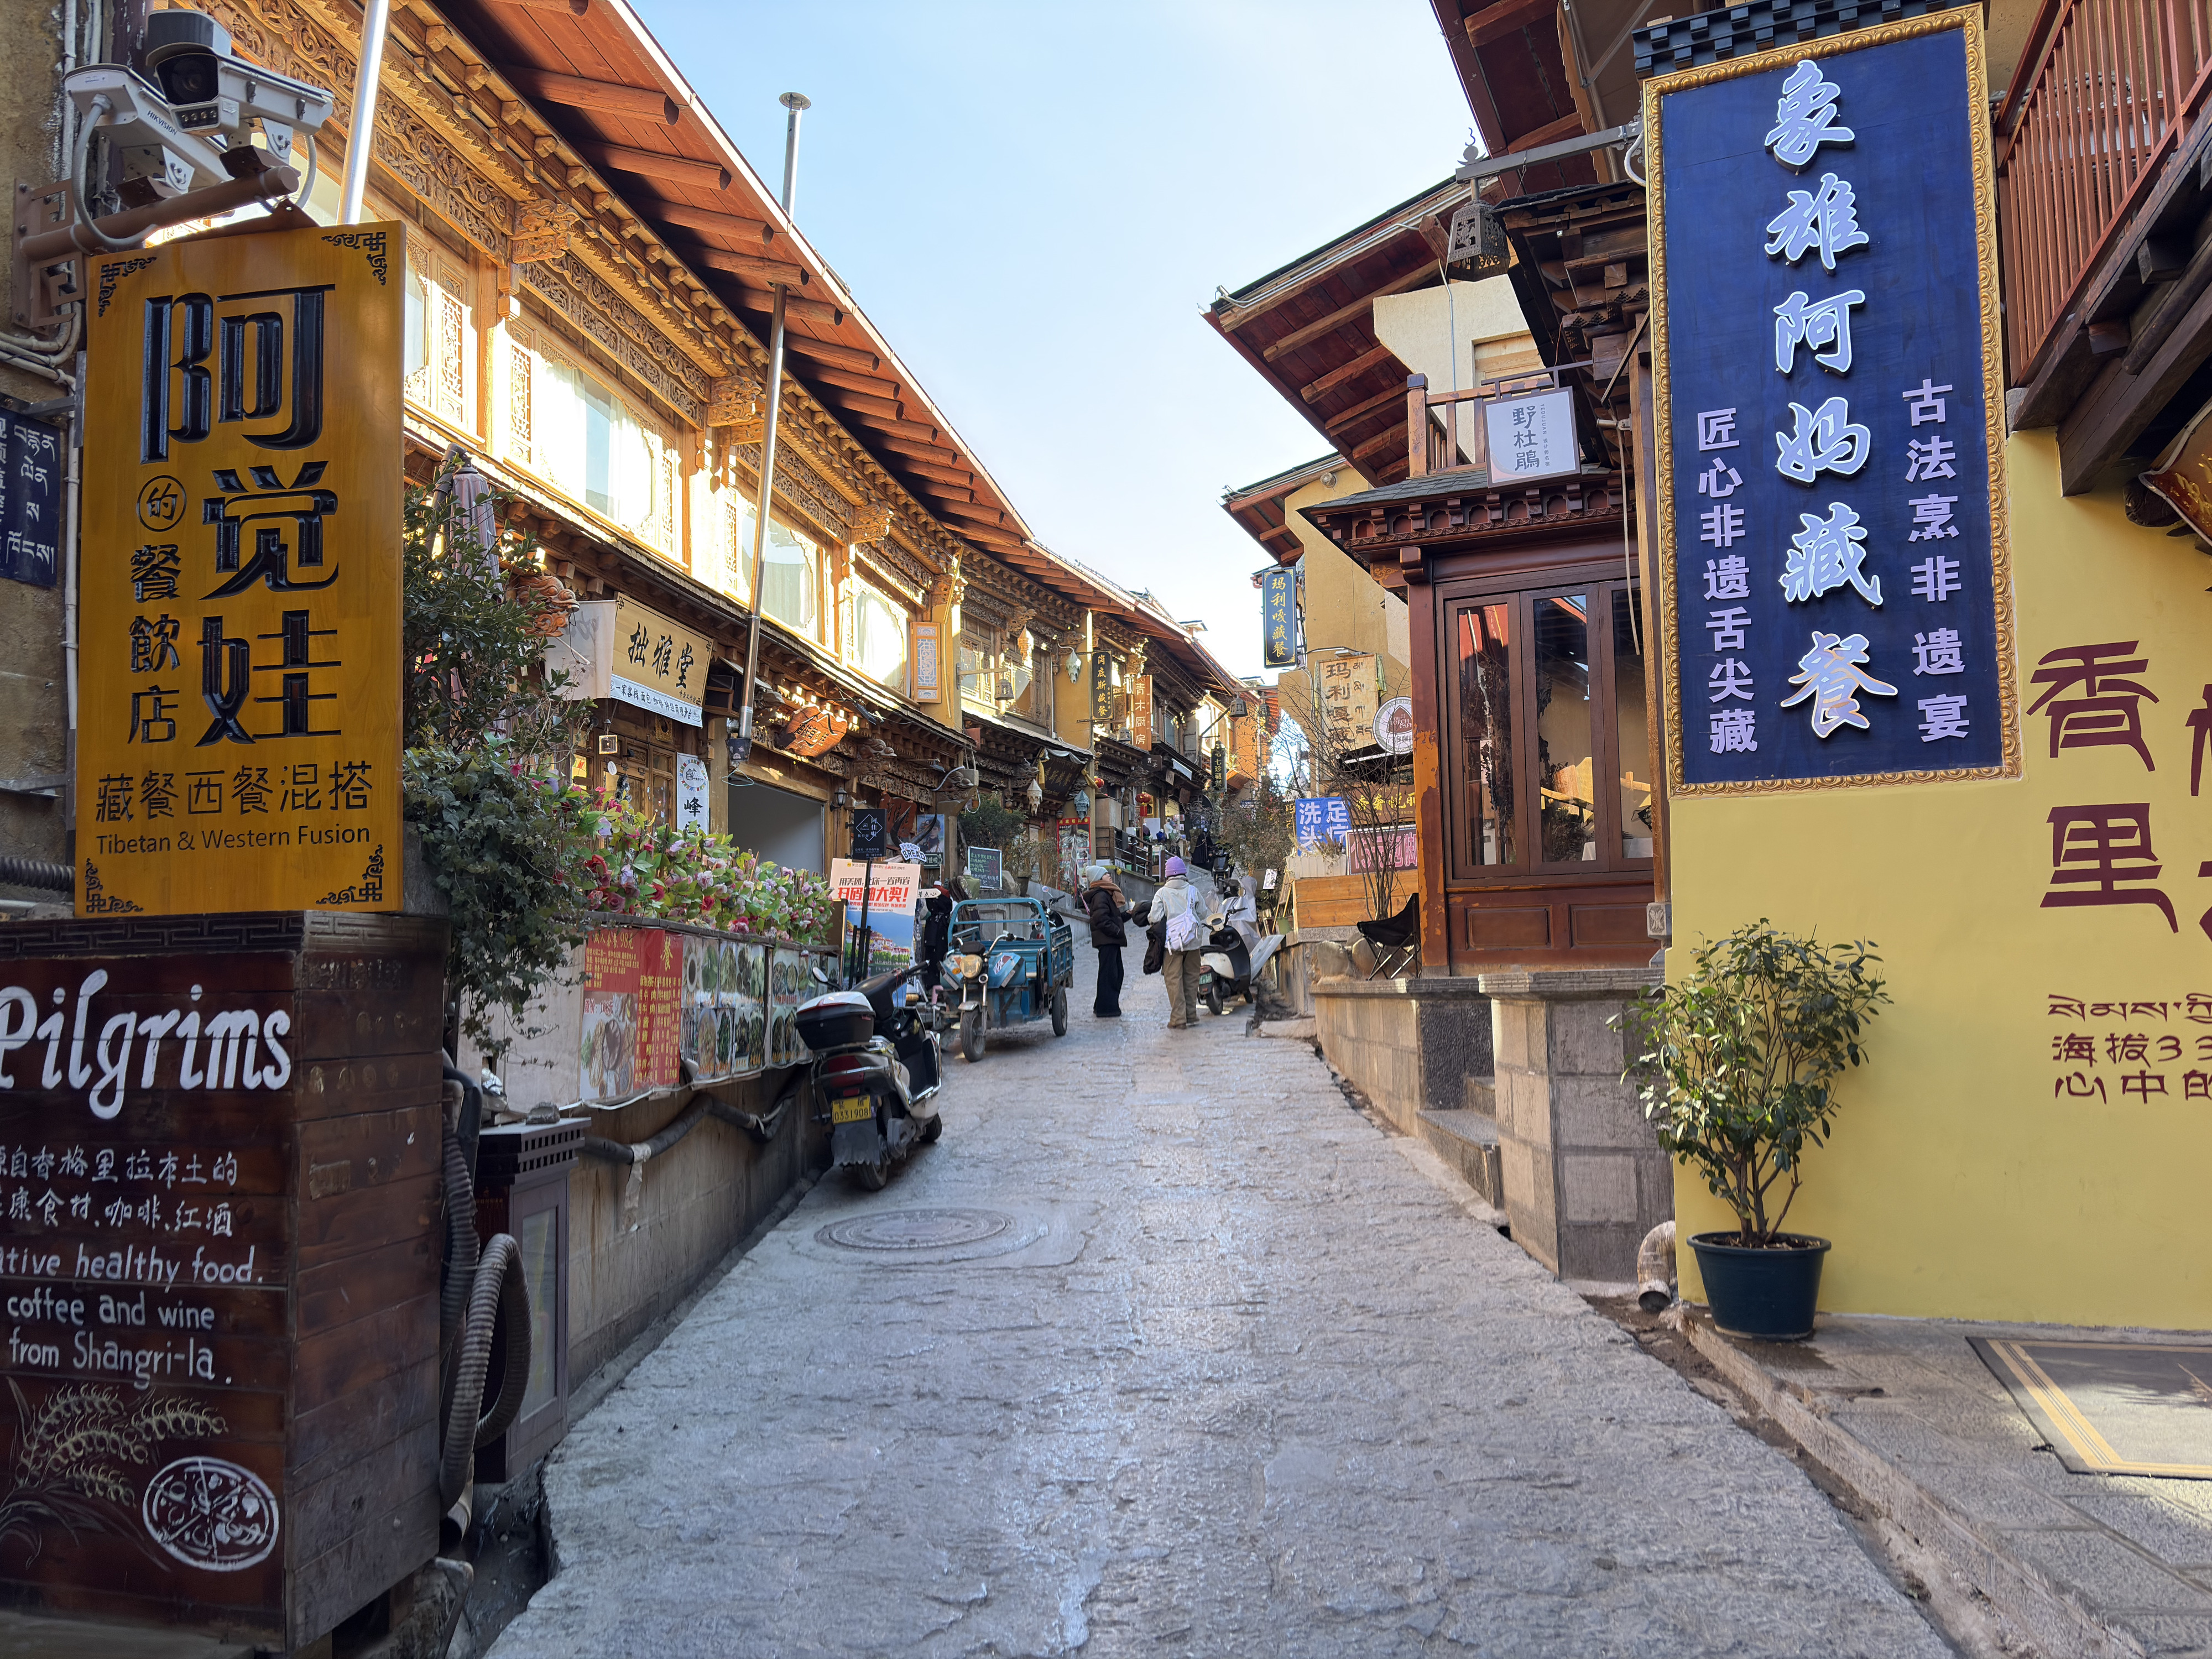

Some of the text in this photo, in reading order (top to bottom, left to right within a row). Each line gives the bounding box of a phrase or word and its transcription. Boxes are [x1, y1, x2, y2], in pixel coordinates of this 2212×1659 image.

[147, 110, 178, 135] HIKVISION
[1764, 59, 1898, 739] 象雄阿妈藏餐
[140, 284, 342, 748] 阿觉娃
[1698, 408, 1757, 754] 匠心非遗舌尖藏
[1903, 378, 1970, 743] 古法烹非遗宴
[1134, 682, 1146, 745] 青木厨房
[96, 760, 372, 823] 藏餐西餐混搭
[96, 823, 370, 855] Tibetan & Western Fusion
[902, 849, 926, 860] BREAD
[0, 968, 291, 1119] Pilgrims
[0, 1246, 61, 1275] tive
[75, 1243, 181, 1293] healthy
[7, 1287, 216, 1330] coffee and wine
[9, 1327, 60, 1368] from
